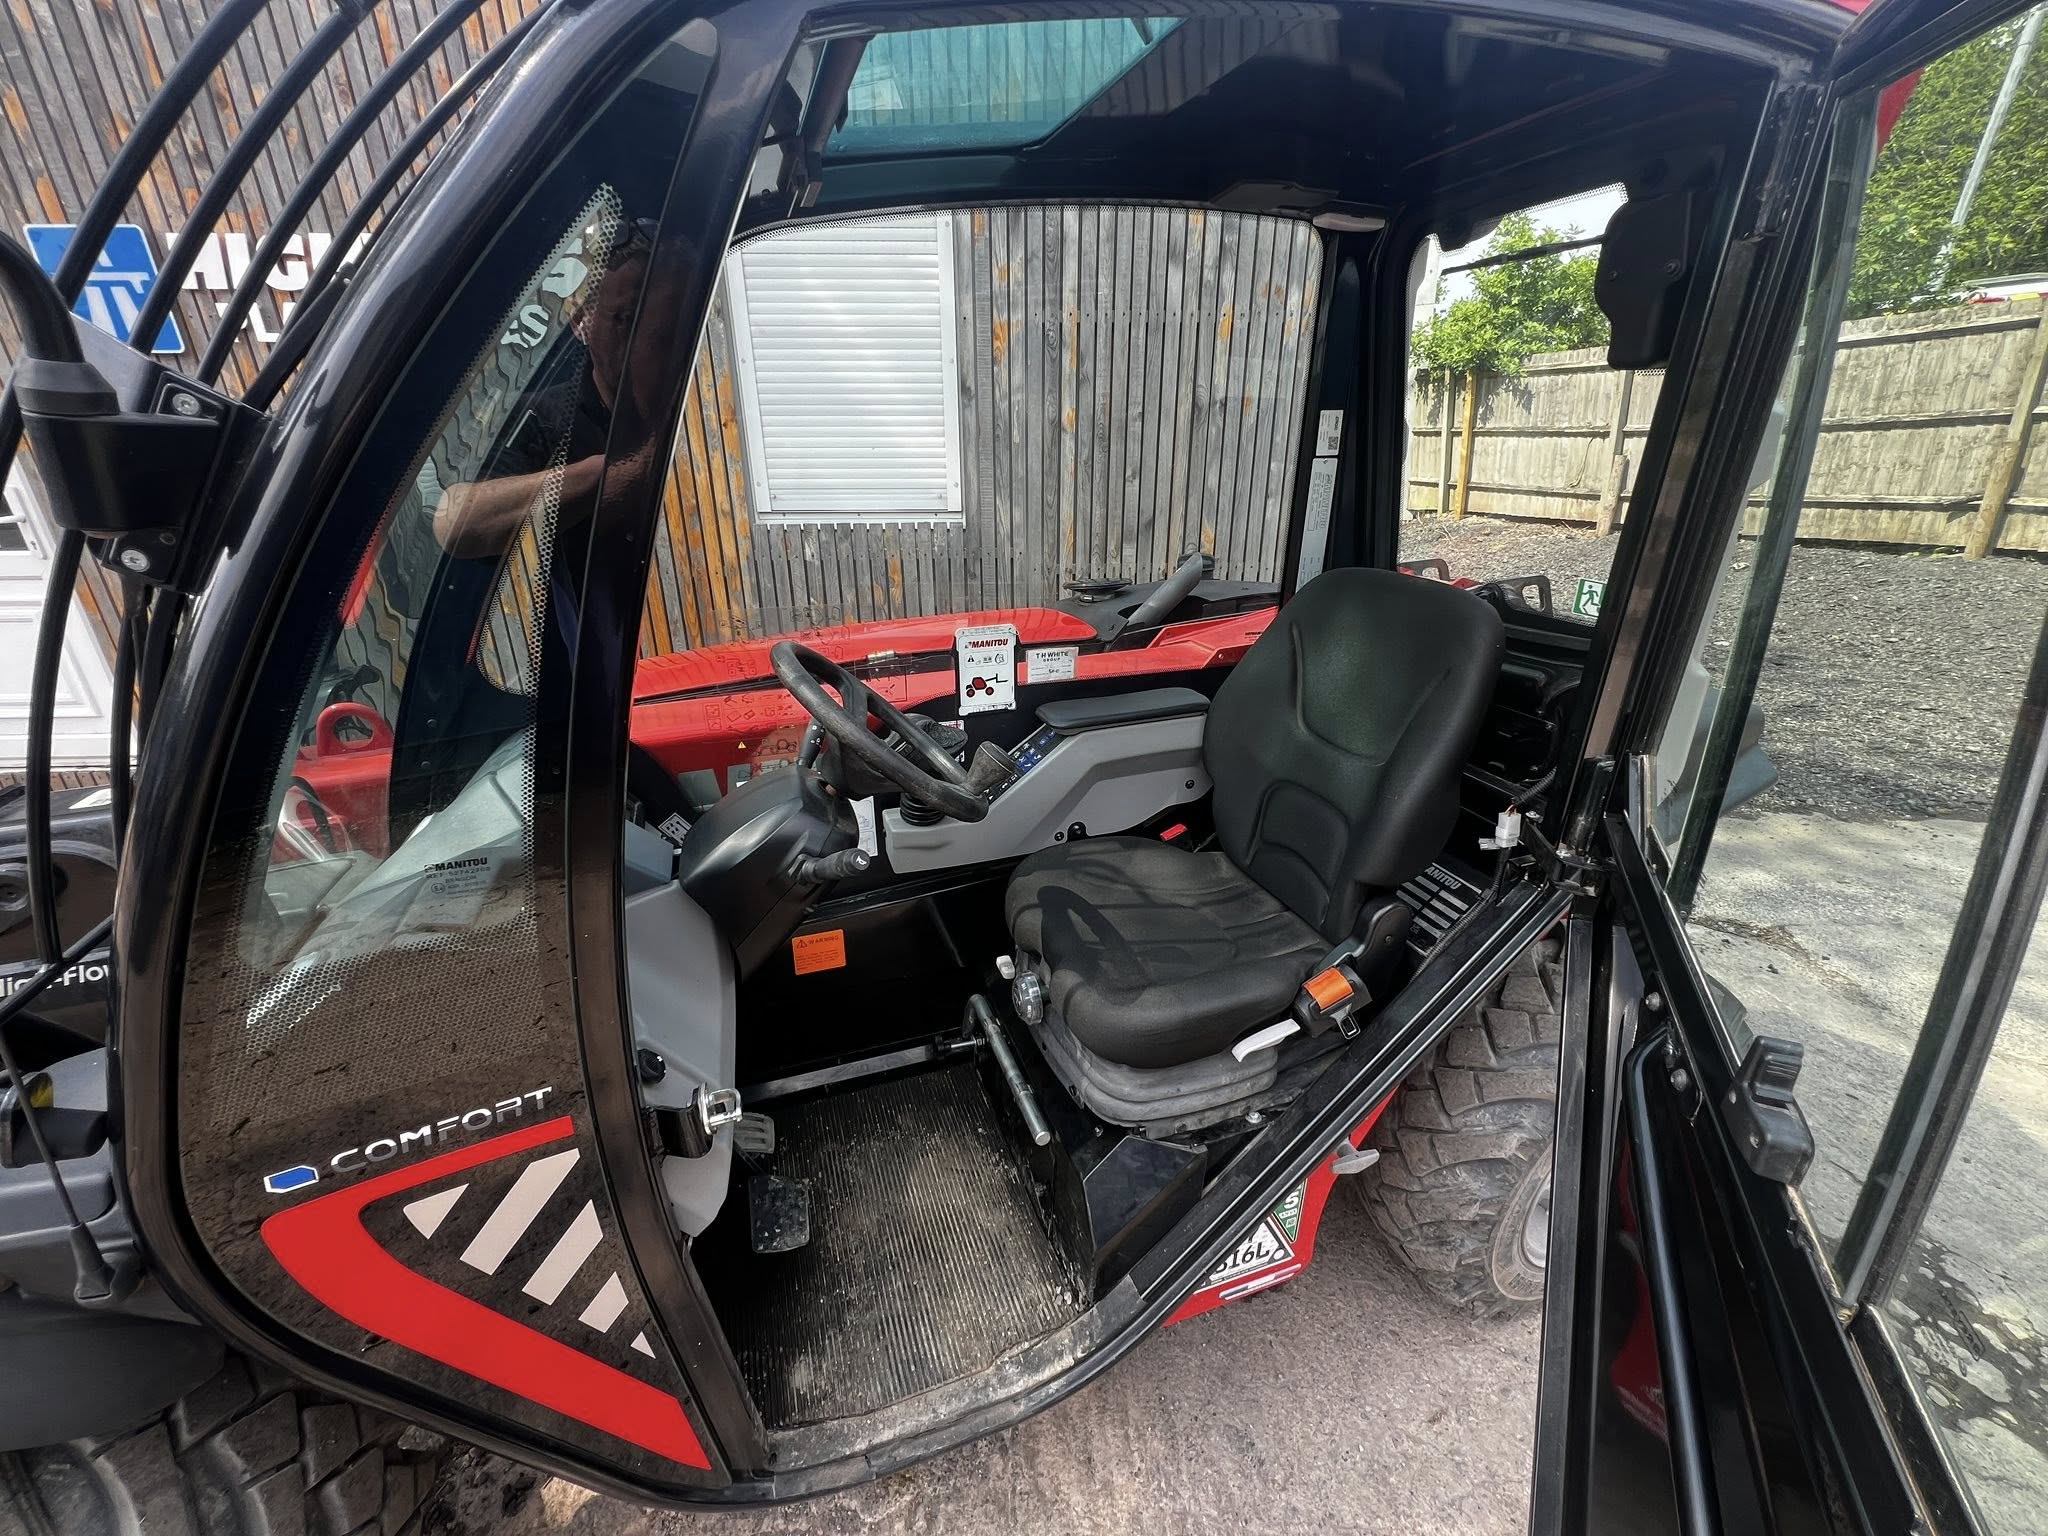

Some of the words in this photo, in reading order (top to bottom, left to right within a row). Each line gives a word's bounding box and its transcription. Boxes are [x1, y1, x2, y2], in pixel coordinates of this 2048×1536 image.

[971, 638, 1009, 649] MANITOU
[435, 857, 488, 871] MANITOU
[1424, 866, 1462, 890] ANITOU
[331, 1086, 553, 1173] COMFORT
